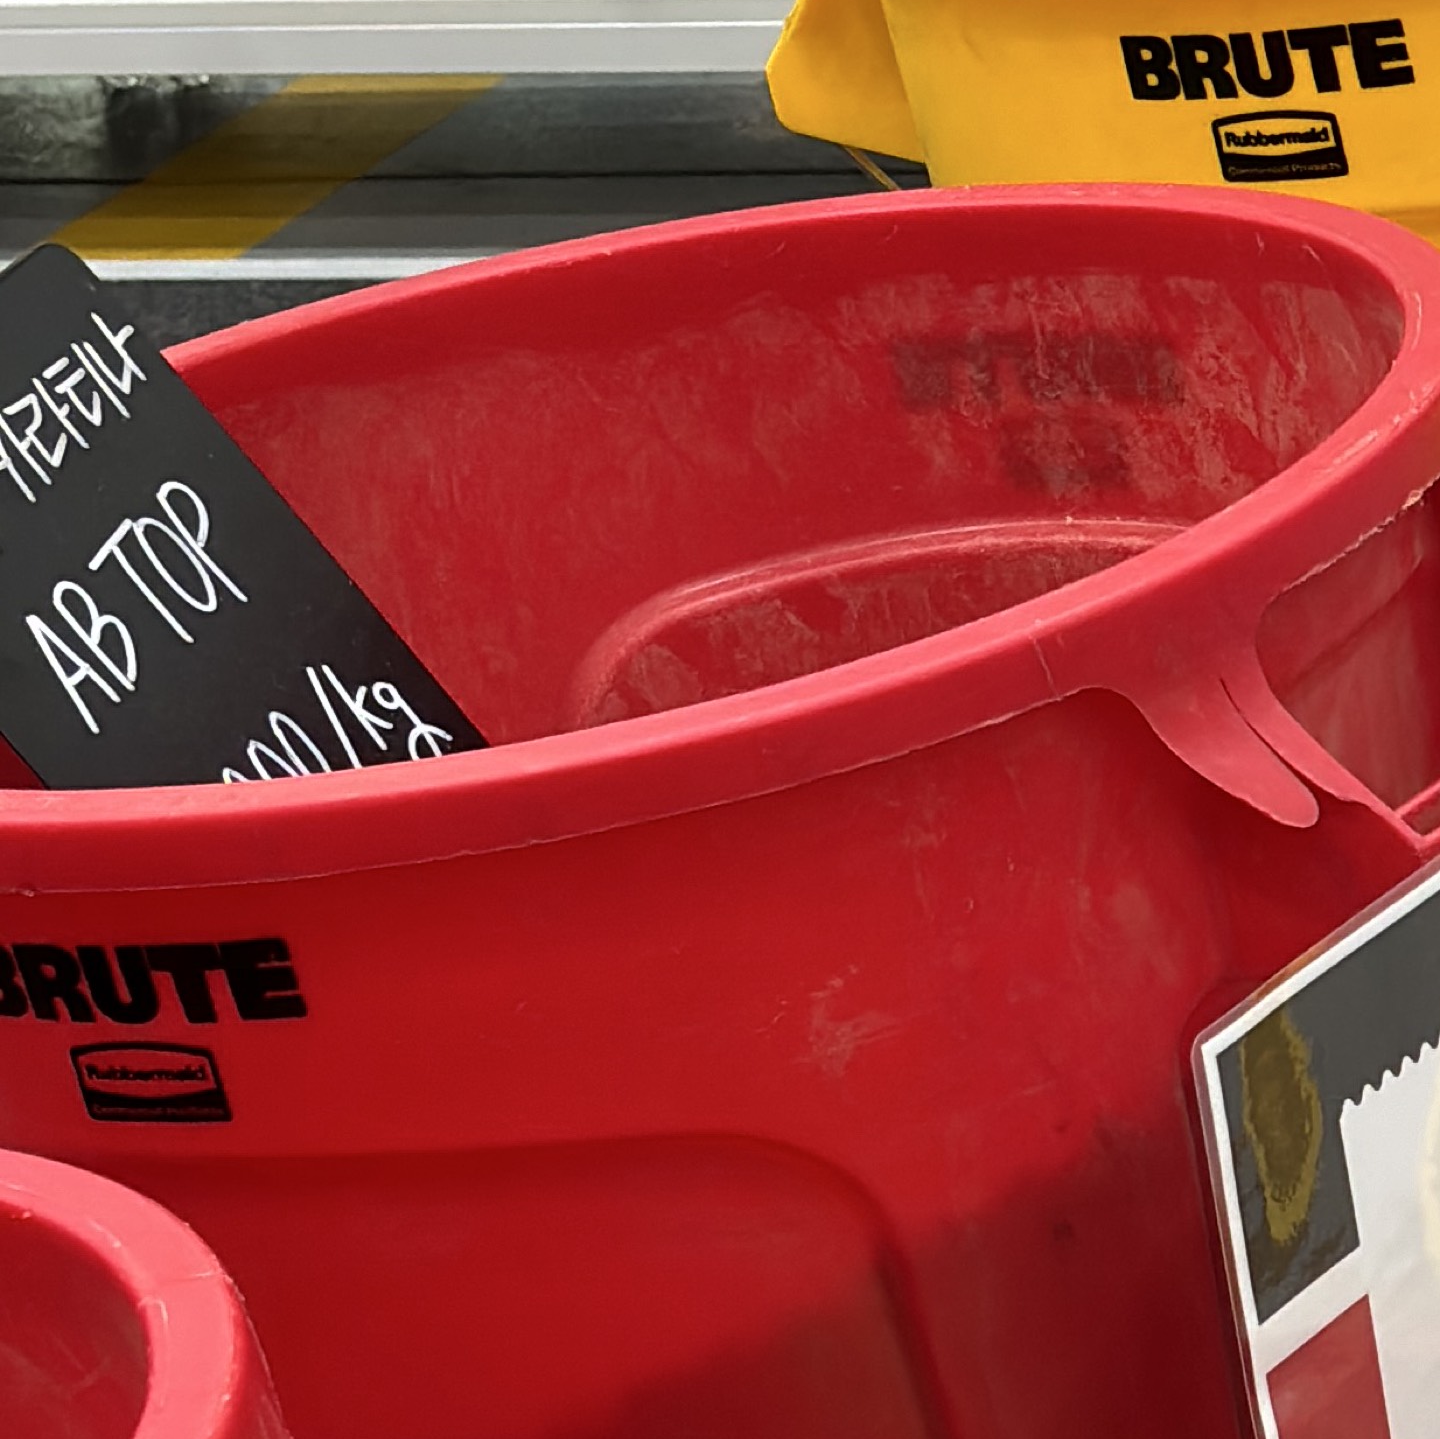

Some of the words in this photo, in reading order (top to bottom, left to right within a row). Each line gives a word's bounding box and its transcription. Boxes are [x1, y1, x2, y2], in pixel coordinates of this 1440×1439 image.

[1120, 18, 1415, 100] BRUTE
[1223, 126, 1330, 148] Rubbermaid
[26, 580, 136, 735] AB
[88, 480, 249, 644] TOP
